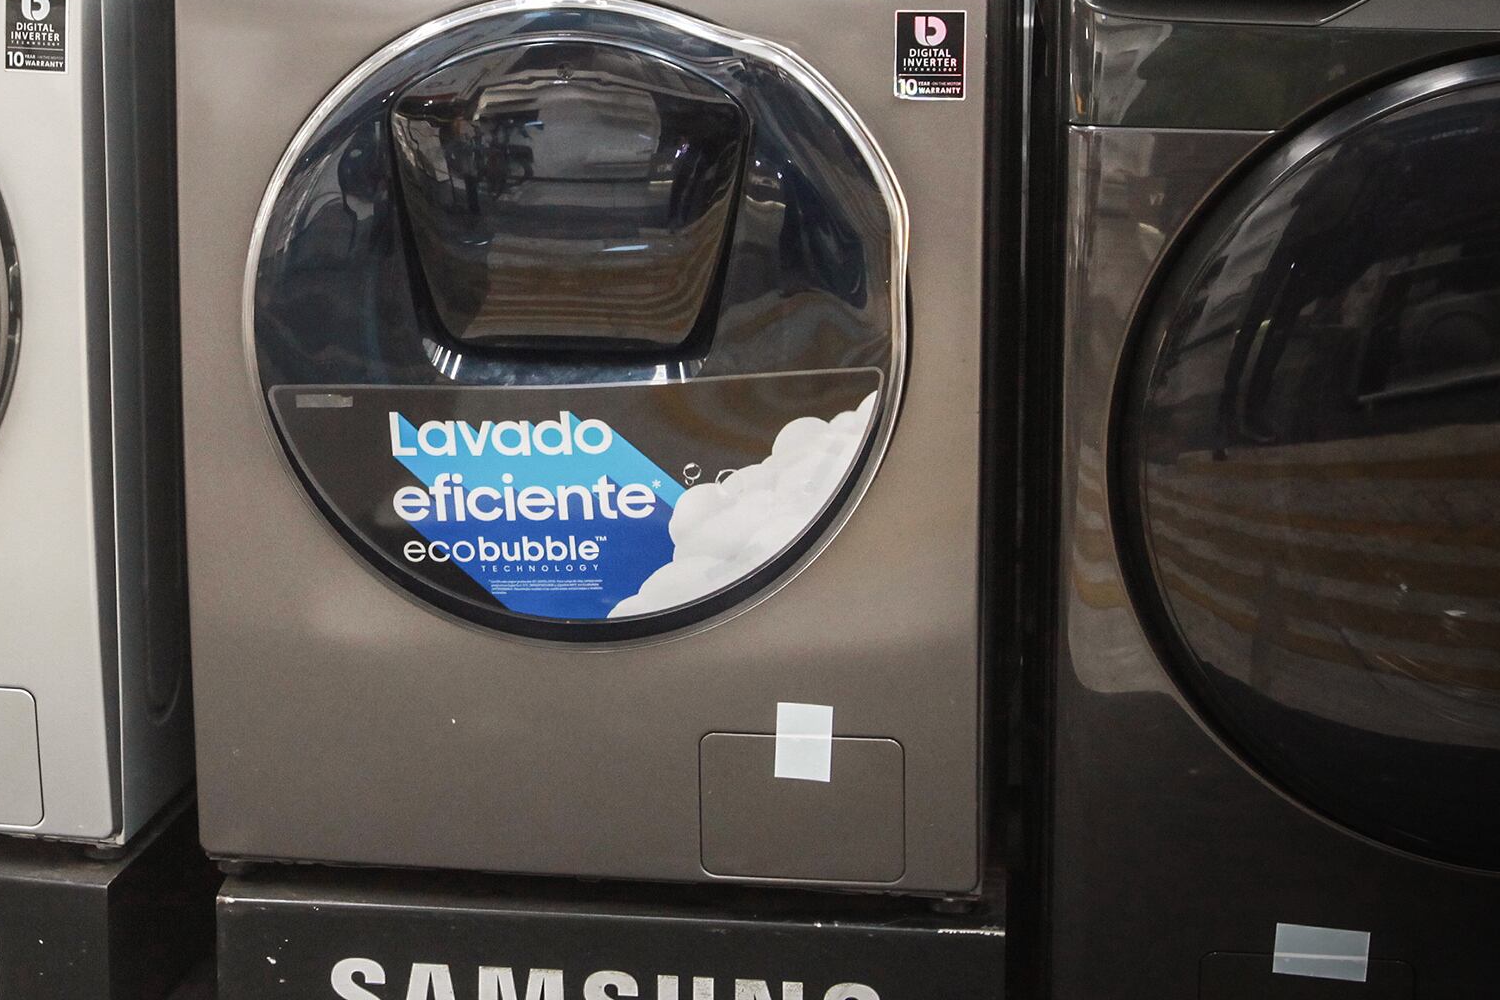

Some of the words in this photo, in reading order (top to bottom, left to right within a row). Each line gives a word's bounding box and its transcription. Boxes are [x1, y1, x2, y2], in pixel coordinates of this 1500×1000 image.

[16, 21, 55, 33] DIGITAL
[10, 31, 60, 42] INVERTER
[909, 48, 952, 58] DIGITAL
[7, 51, 24, 67] 10
[25, 60, 63, 68] WARRANTY
[903, 58, 957, 67] INVERTER
[898, 79, 917, 96] 10
[389, 410, 613, 457] Lavado
[481, 563, 599, 573] TECHNOLOGY
